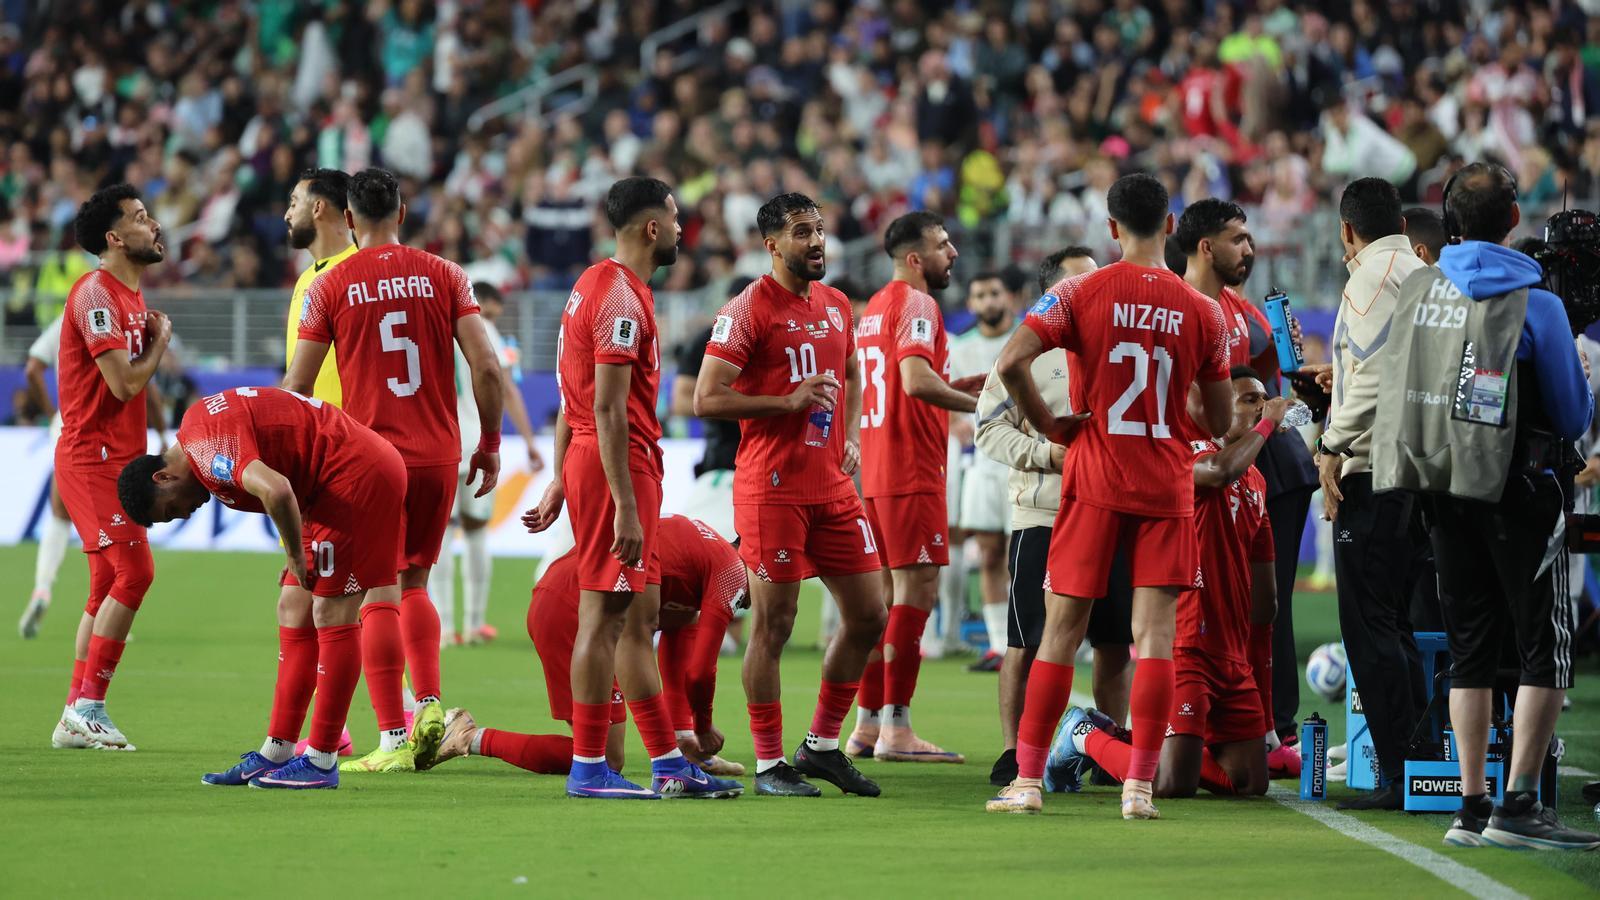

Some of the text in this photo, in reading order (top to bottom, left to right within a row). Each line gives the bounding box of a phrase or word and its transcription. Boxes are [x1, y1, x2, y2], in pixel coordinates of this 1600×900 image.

[347, 275, 434, 307] ALARAB
[1113, 302, 1184, 336] NIZAR
[1413, 302, 1467, 329] 0229
[378, 310, 422, 398] 5
[785, 342, 818, 384] 10
[1108, 341, 1173, 438] 21
[856, 518, 878, 554] 1
[1313, 732, 1324, 793] POWERADE
[1412, 779, 1491, 793] POWERE
